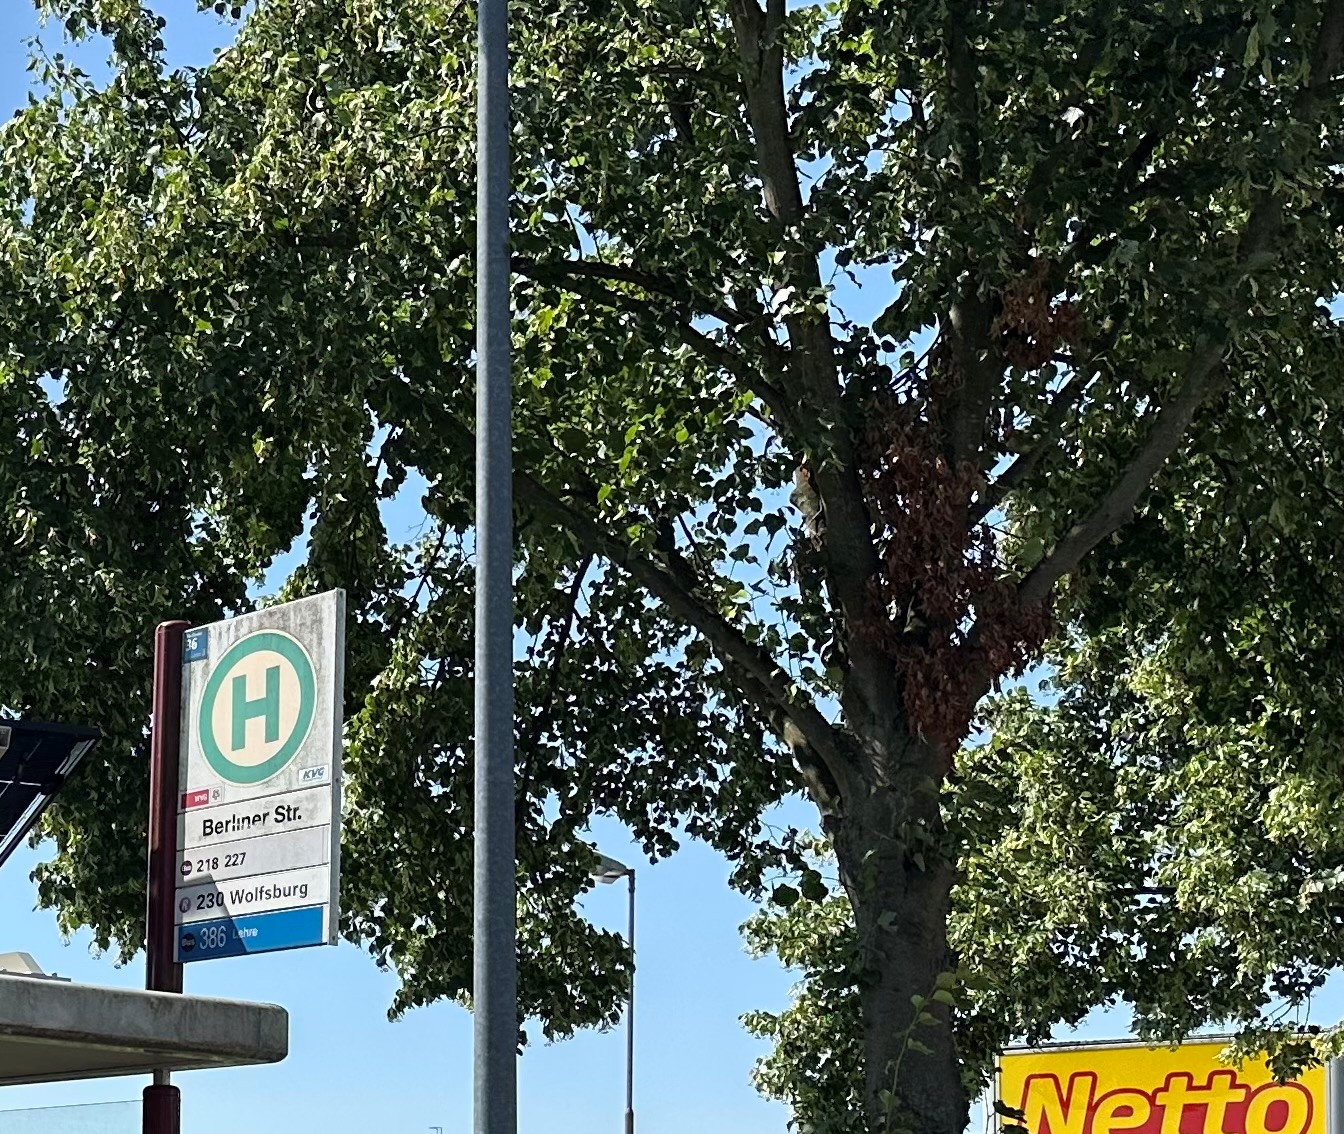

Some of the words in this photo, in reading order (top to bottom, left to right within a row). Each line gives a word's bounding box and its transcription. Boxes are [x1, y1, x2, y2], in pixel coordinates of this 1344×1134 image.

[232, 665, 280, 752] H
[303, 767, 325, 780] KVG
[202, 812, 270, 836] Berliner
[274, 804, 302, 824] Str.
[197, 858, 218, 872] 218
[224, 852, 246, 868] 227
[196, 889, 224, 911] 230
[230, 881, 308, 906] Wolfsburg
[200, 926, 226, 949] 386
[232, 925, 258, 940] Lehre
